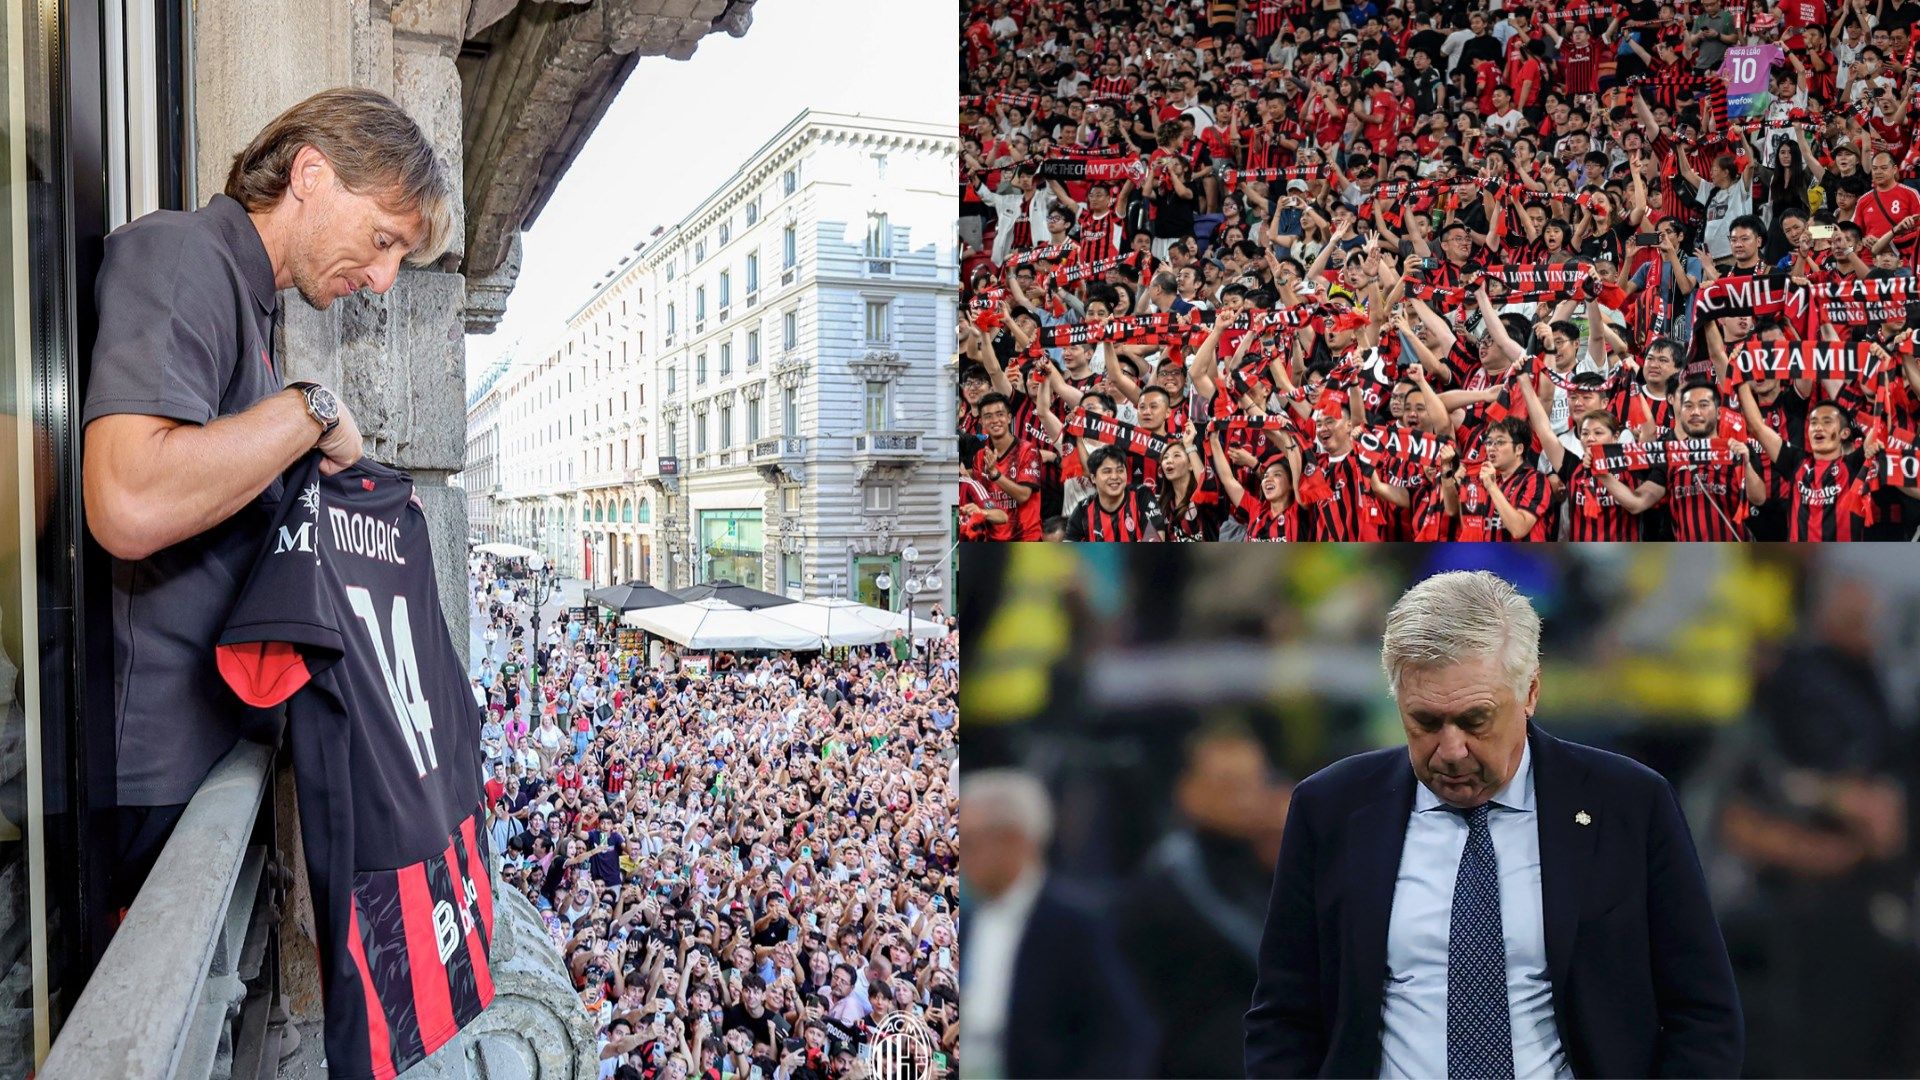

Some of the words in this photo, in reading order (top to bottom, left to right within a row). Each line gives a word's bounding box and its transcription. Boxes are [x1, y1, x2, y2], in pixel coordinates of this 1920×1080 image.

[1732, 57, 1757, 84] 10
[1728, 96, 1753, 105] wefox
[1890, 199, 1901, 214] 8
[1509, 271, 1542, 283] LOTTA
[1132, 316, 1162, 325] CLUB
[1827, 310, 1865, 323] HONG
[1868, 306, 1907, 321] KONG
[1736, 348, 1806, 373] ORZA
[1812, 347, 1881, 379] MIL
[1025, 422, 1054, 444] Emira
[1090, 419, 1126, 439] LOTTA
[1129, 430, 1167, 453] VINCE
[1622, 441, 1664, 453] KONG
[1669, 438, 1712, 451] HONG
[1595, 455, 1633, 471] CLUB
[1638, 452, 1666, 465] FAN
[1798, 480, 1842, 499] Emirates
[328, 505, 406, 565] MODRIĆ
[345, 585, 439, 779] 14
